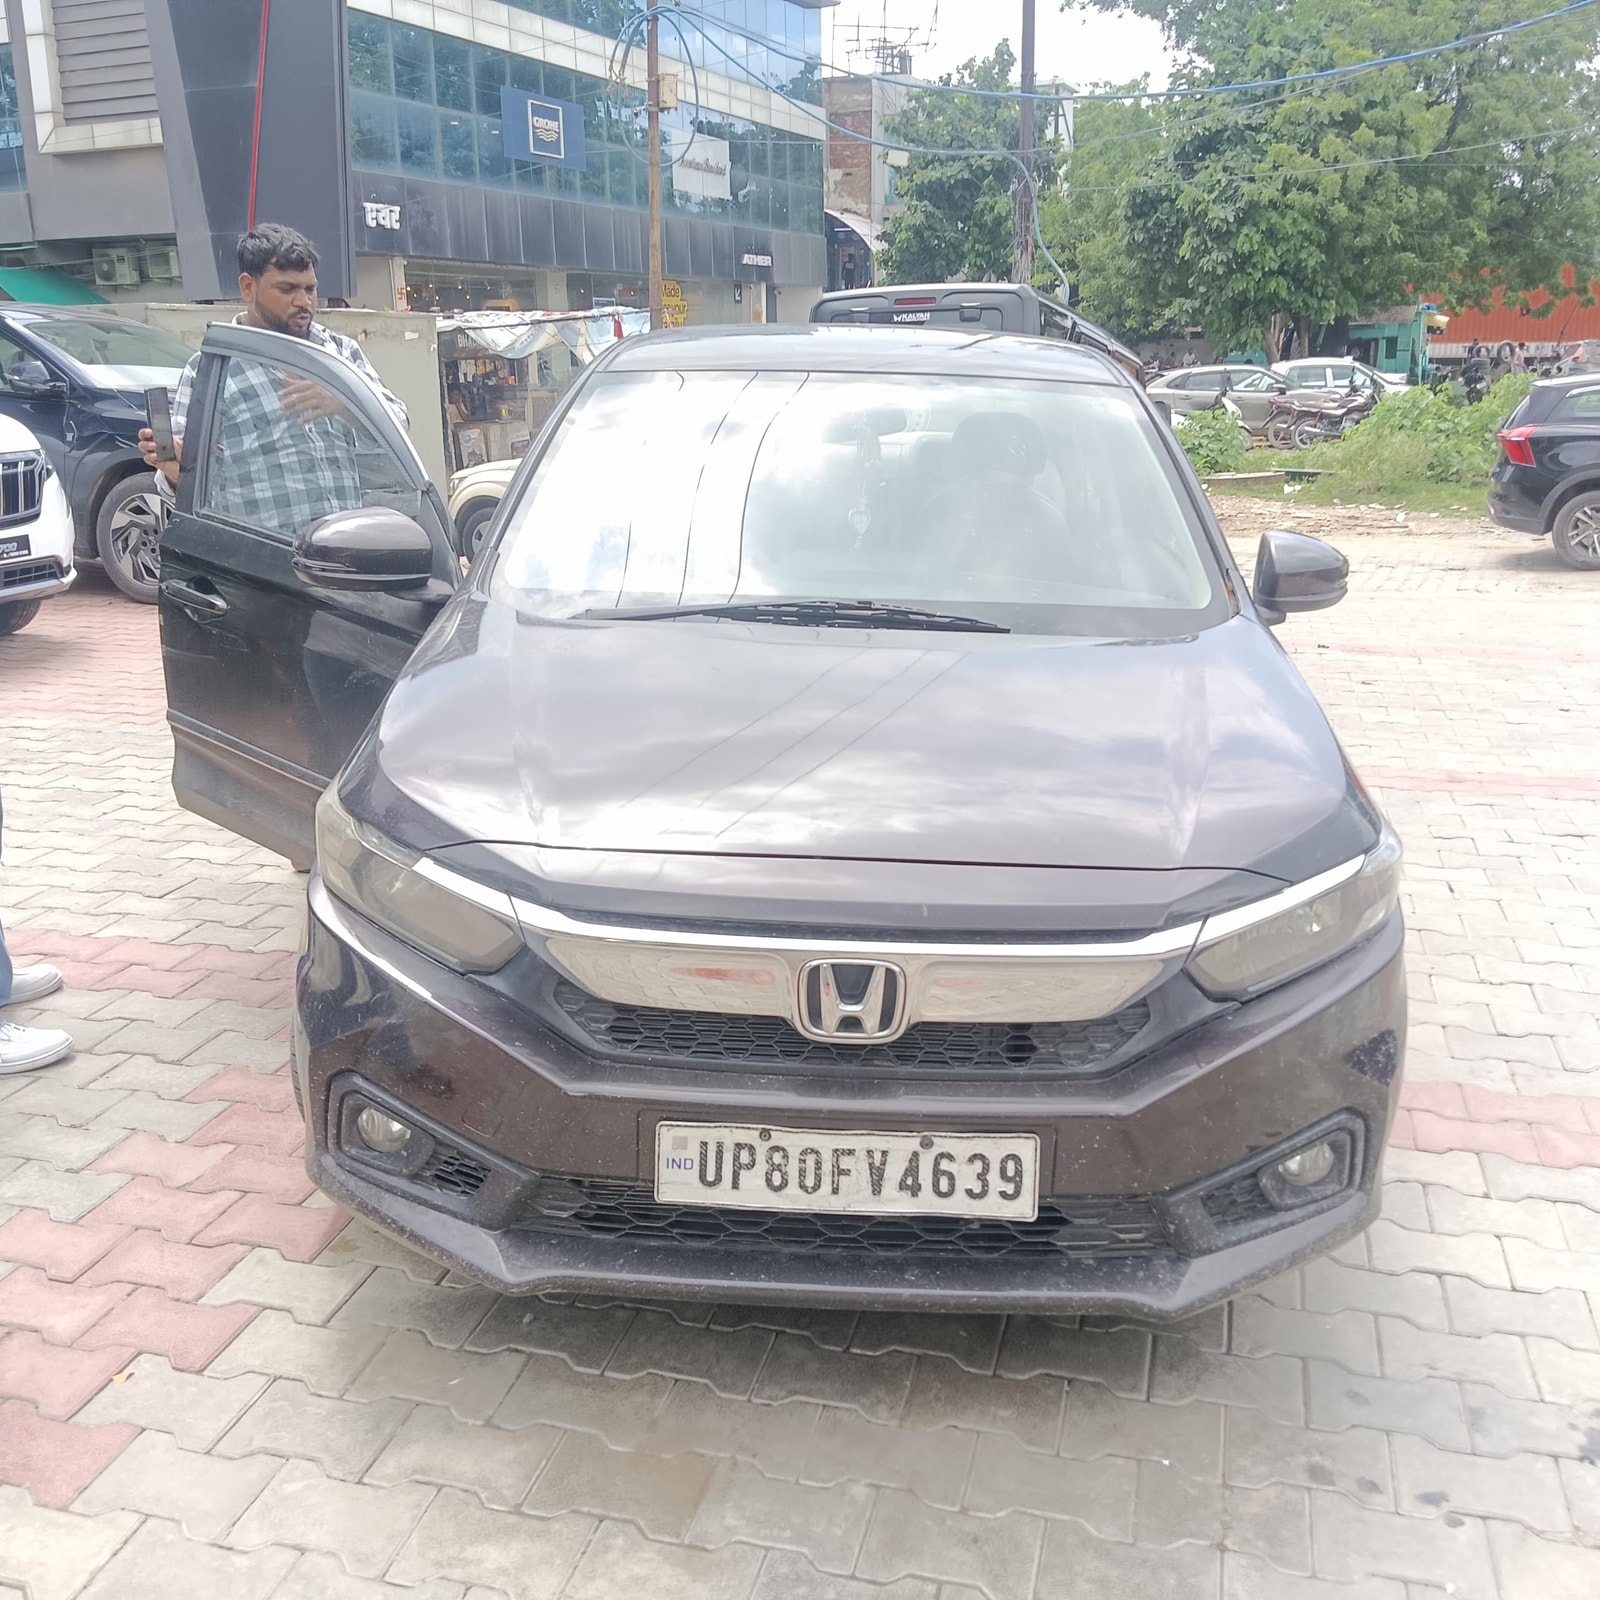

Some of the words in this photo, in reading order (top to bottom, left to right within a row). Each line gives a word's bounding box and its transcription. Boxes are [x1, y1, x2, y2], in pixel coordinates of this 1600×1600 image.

[533, 116, 559, 131] GROHE
[742, 253, 773, 267] ATHER
[902, 311, 931, 322] KALYAN
[666, 1157, 694, 1170] IND
[699, 1141, 1024, 1200] UP80FV4639
